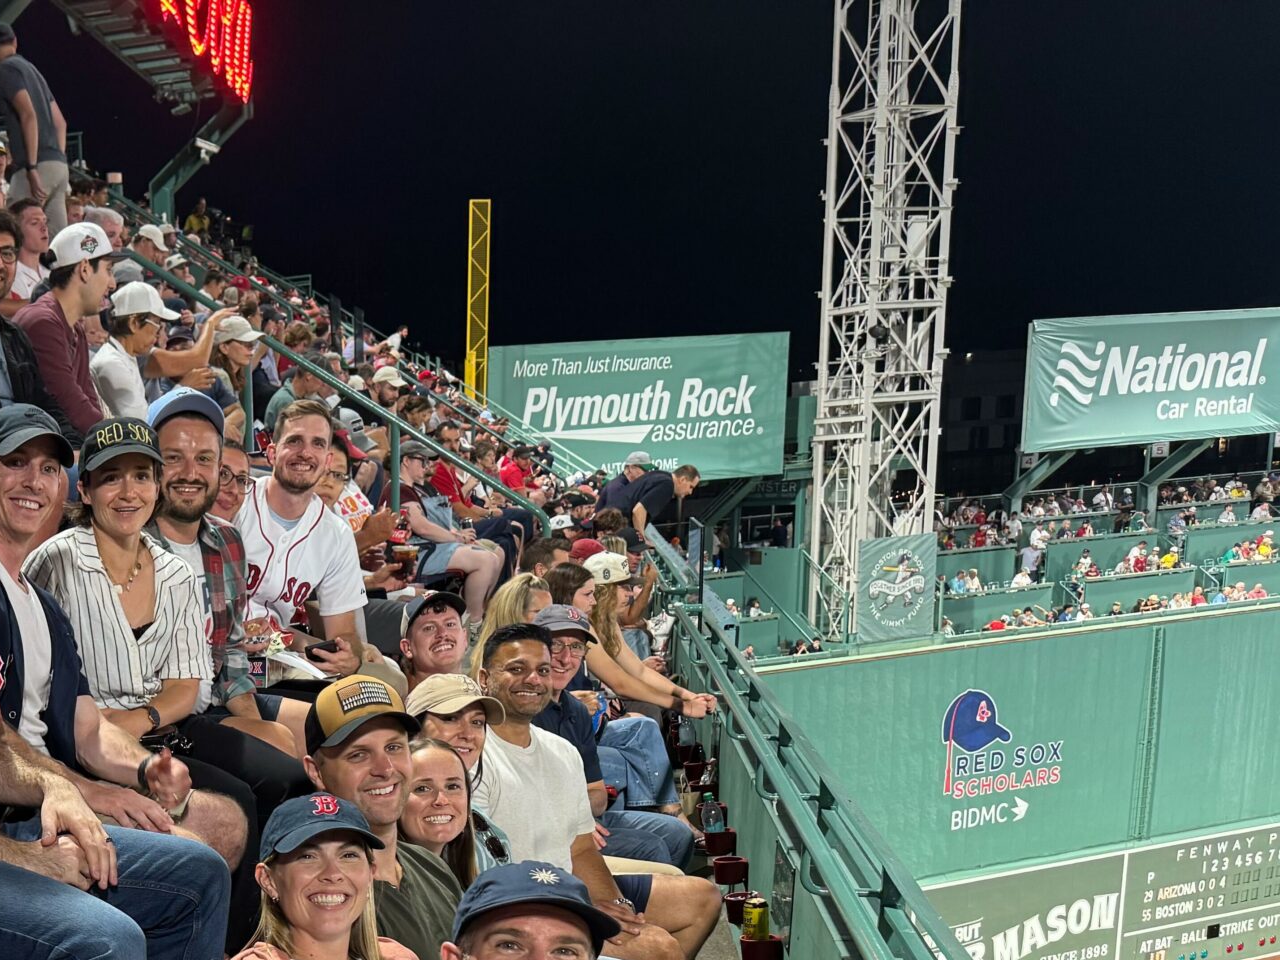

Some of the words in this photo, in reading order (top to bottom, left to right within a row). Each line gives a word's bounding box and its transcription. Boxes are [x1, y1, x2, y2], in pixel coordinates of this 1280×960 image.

[513, 359, 548, 378] More
[552, 357, 582, 376] Than
[584, 356, 610, 374] Just
[612, 355, 673, 372] Insurance.
[1099, 338, 1267, 396] National
[521, 380, 670, 432] Plymouth
[677, 375, 757, 418] Rock
[1156, 399, 1189, 420] Car
[1195, 393, 1254, 417] Rental
[96, 422, 123, 450] RED
[128, 422, 153, 446] SOX
[651, 418, 755, 442] assurance
[1025, 457, 1033, 465] 4
[1156, 446, 1164, 455] 5
[280, 576, 311, 608] SO
[955, 750, 1005, 777] RED
[1013, 741, 1064, 767] SOX
[953, 766, 1061, 799] SCHOLARS
[309, 796, 340, 815] B
[951, 802, 1009, 831] BIDMC
[1176, 837, 1255, 861] FENWAY
[1148, 872, 1155, 884] P
[1144, 890, 1153, 903] 29
[1157, 882, 1196, 900] ARIZONA
[1142, 909, 1151, 921] 55
[1156, 900, 1193, 919] BOSTON
[955, 922, 981, 942] BUT
[1140, 940, 1152, 954] AT
[1155, 936, 1173, 950] BAT
[1181, 929, 1207, 945] BALL
[1219, 919, 1254, 938] STRIKE
[1258, 914, 1280, 929] OUT
[1080, 944, 1108, 960] 1898
